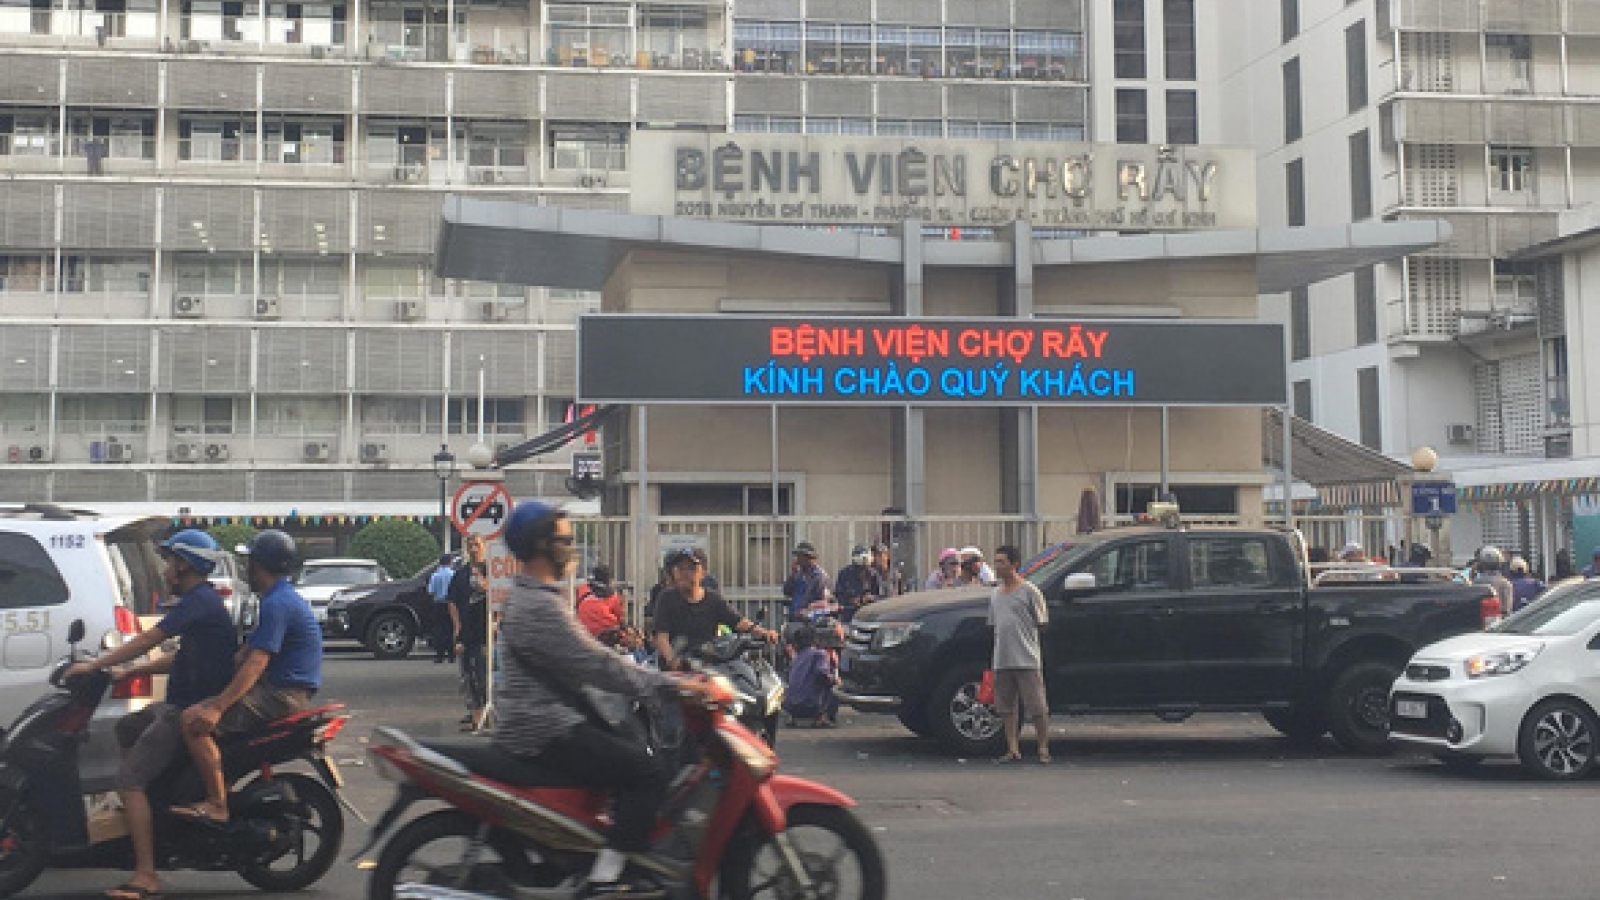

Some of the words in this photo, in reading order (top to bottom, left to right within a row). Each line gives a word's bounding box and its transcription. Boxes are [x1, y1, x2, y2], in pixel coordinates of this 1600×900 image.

[676, 140, 821, 200] BỆNH
[844, 146, 966, 204] VIỆN
[989, 153, 1094, 207] CHỢ
[770, 323, 864, 363] BỆNH
[872, 323, 949, 363] VIỆN
[957, 326, 1035, 363] CHỢ
[743, 359, 824, 395] KÍNH
[834, 360, 932, 396] CHÀO
[940, 361, 1011, 397] QUÝ
[1019, 361, 1135, 397] KHÁCH
[49, 534, 86, 549] 1152
[0, 610, 50, 631] 5.51
